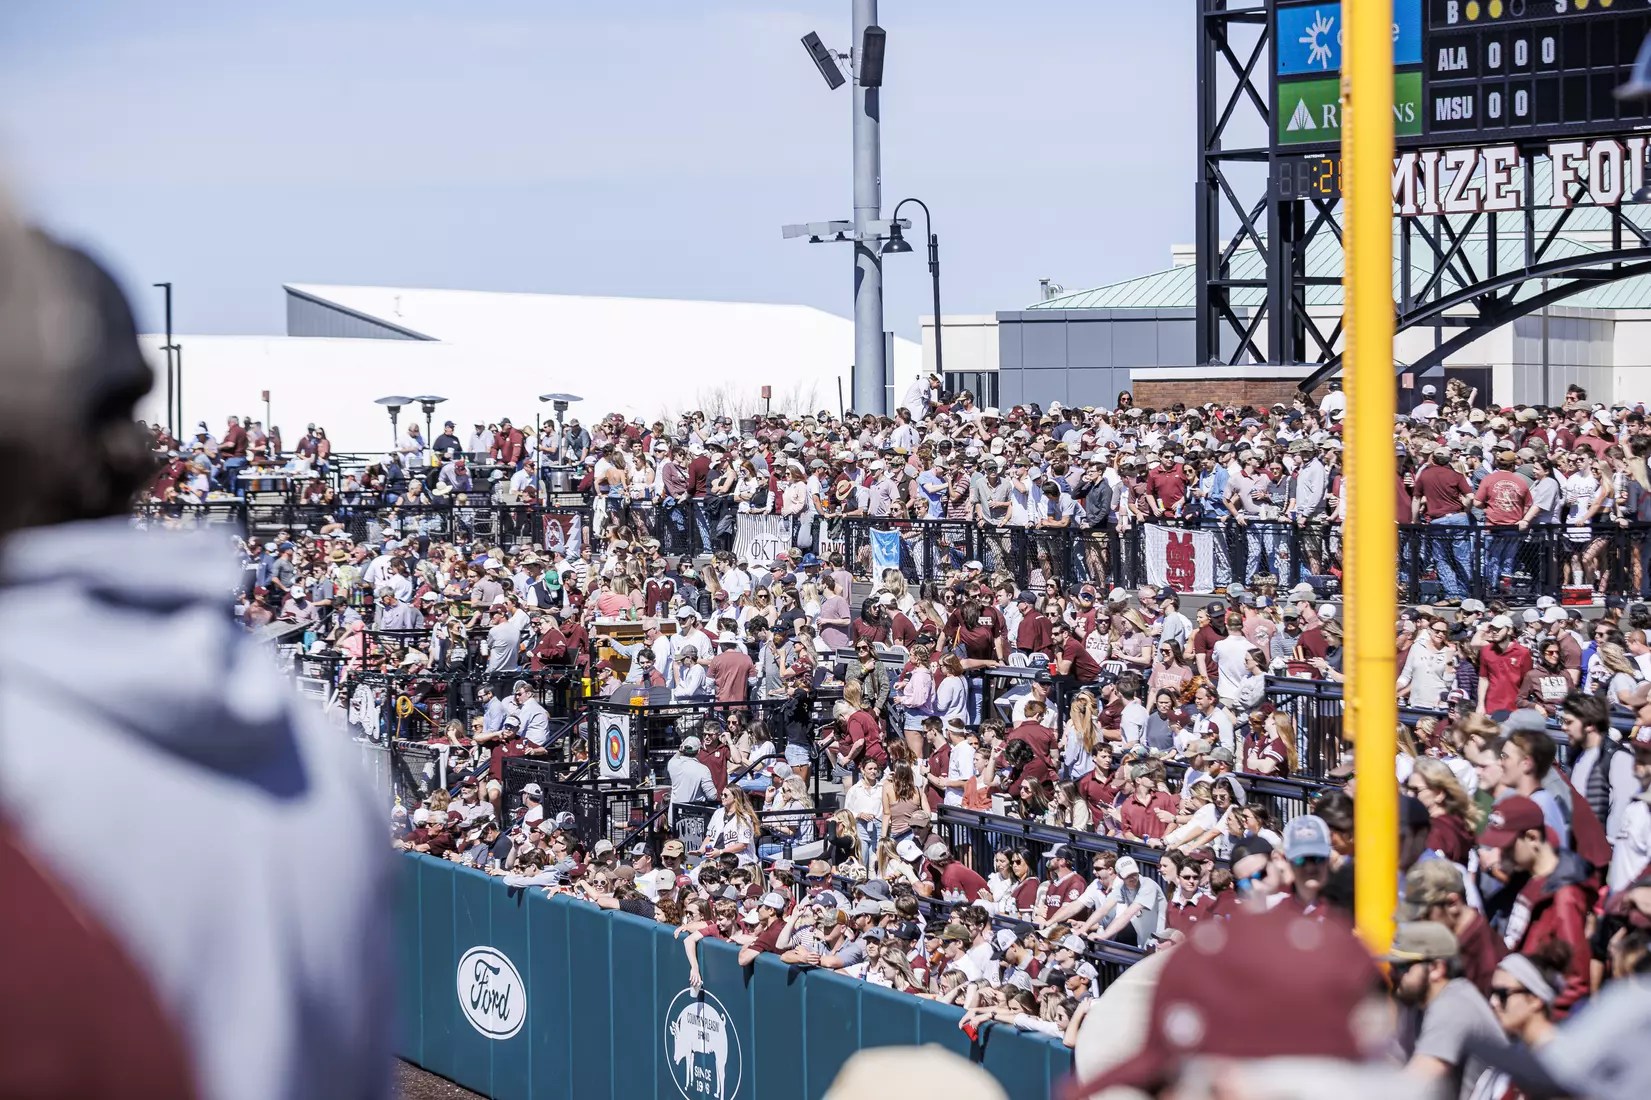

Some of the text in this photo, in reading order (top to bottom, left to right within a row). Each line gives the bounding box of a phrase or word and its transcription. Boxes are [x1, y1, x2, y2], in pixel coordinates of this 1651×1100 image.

[1447, 0, 1459, 24] B
[1437, 36, 1555, 71] ALA 0 0 0
[1436, 95, 1473, 121] MSU
[1488, 91, 1501, 118] 0
[1515, 89, 1528, 116] 0
[470, 959, 511, 1021] Ford
[694, 1065, 711, 1082] SINCE
